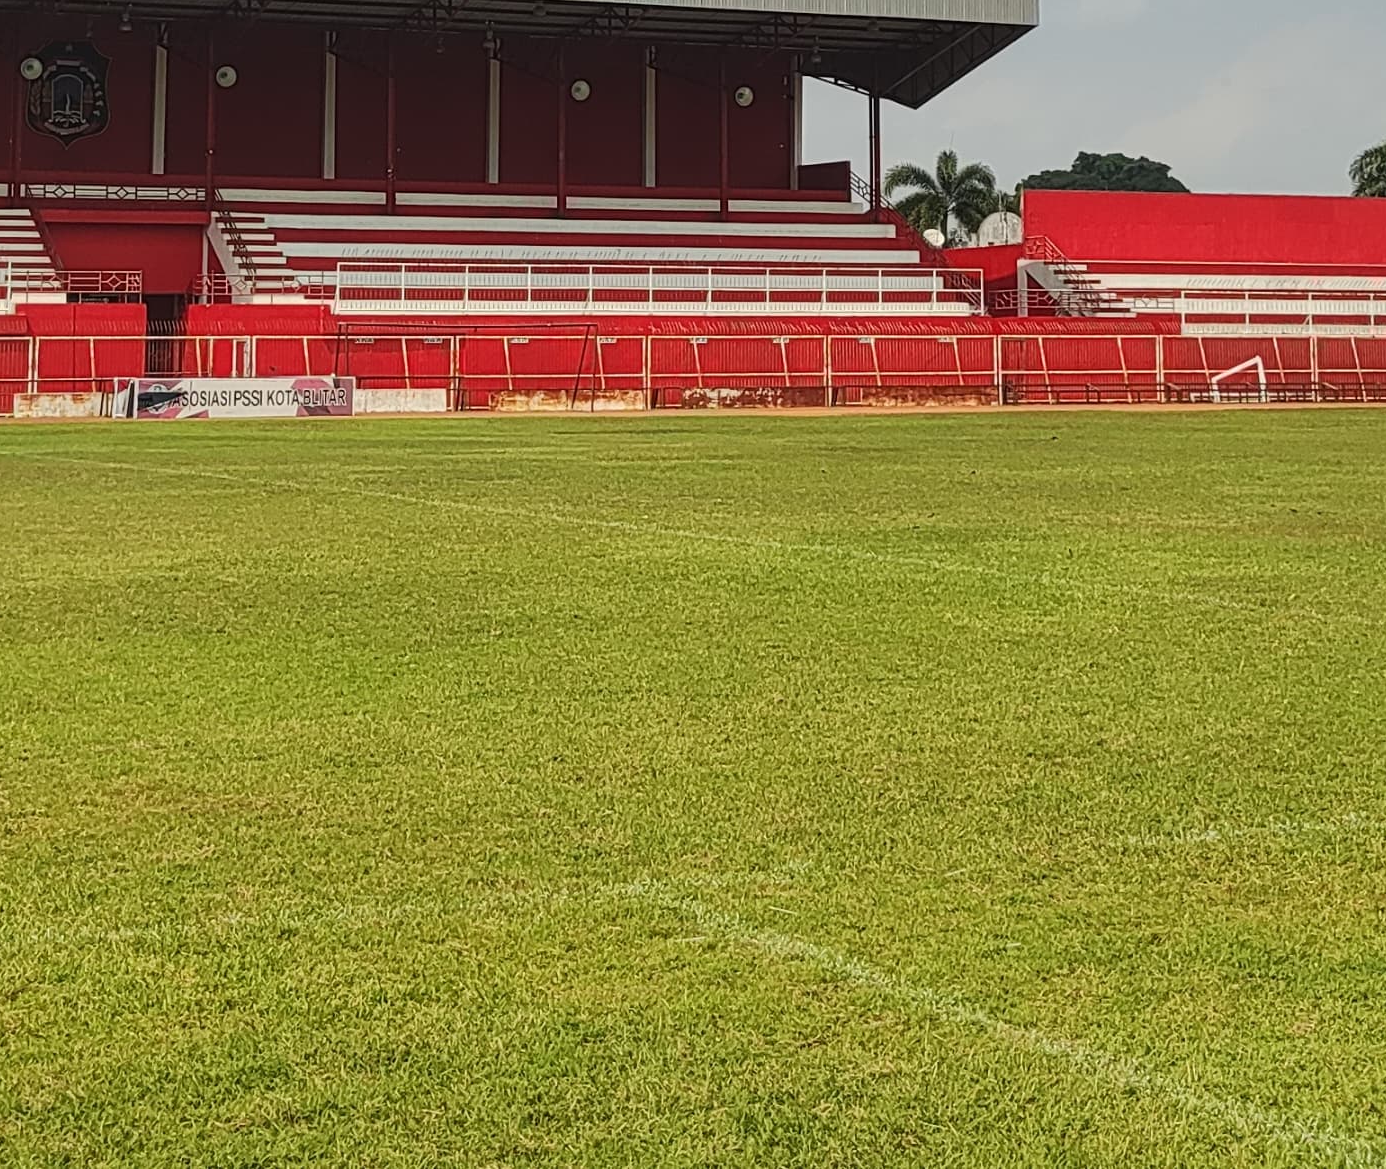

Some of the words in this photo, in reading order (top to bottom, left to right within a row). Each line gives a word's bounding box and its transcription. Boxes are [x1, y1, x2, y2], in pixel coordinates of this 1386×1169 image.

[234, 390, 262, 406] PSSI
[267, 390, 299, 406] KOTA
[303, 389, 347, 406] BLITAR
